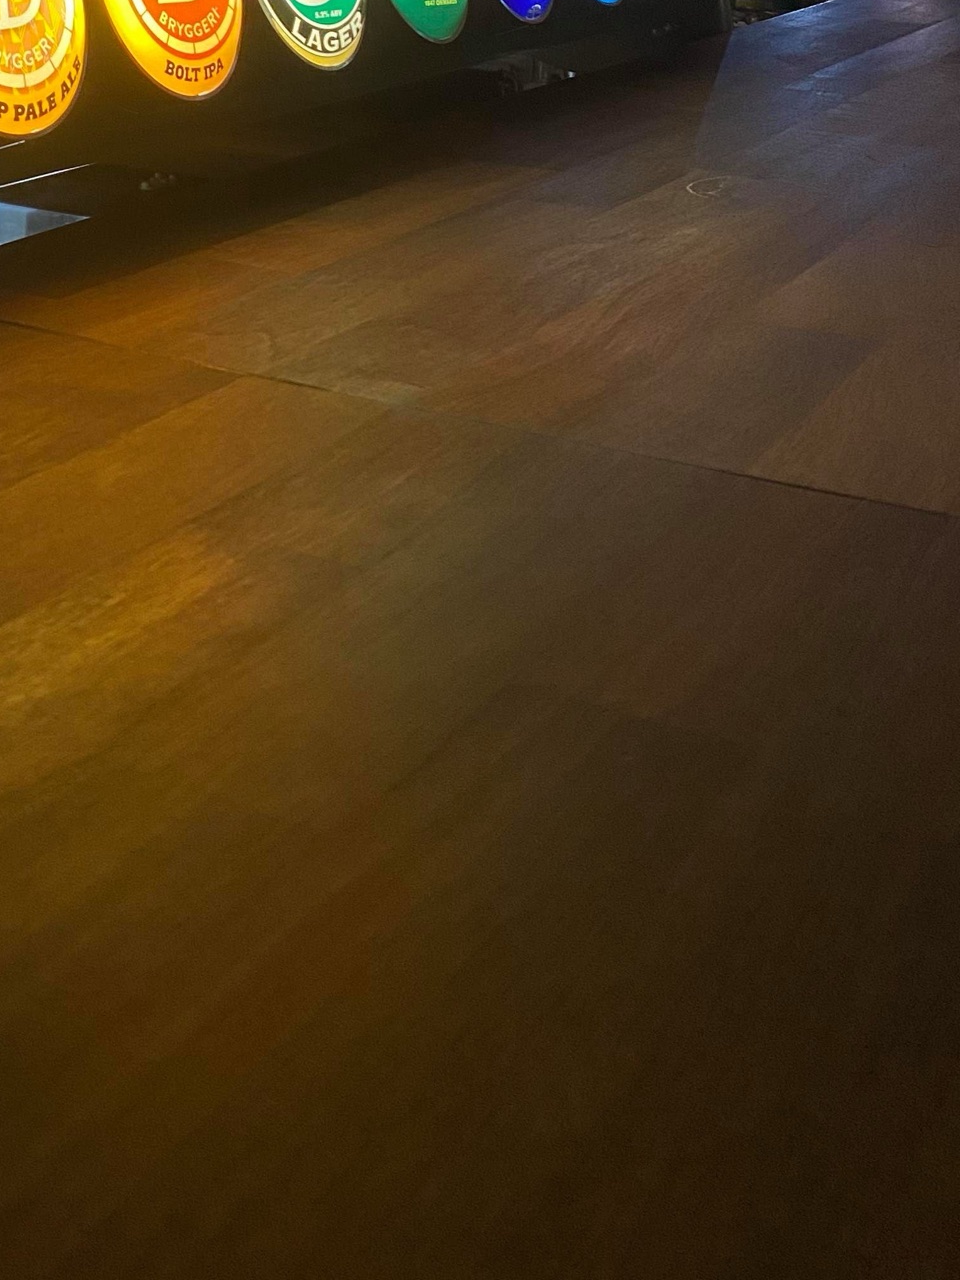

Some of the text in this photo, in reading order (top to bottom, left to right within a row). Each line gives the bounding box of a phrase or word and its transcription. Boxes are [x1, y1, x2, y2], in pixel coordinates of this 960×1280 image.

[159, 6, 220, 38] BRYGGERI
[291, 10, 364, 51] LAGER
[165, 57, 225, 83] BOLT IPA
[13, 90, 58, 123] PALE
[60, 54, 82, 101] ALE
